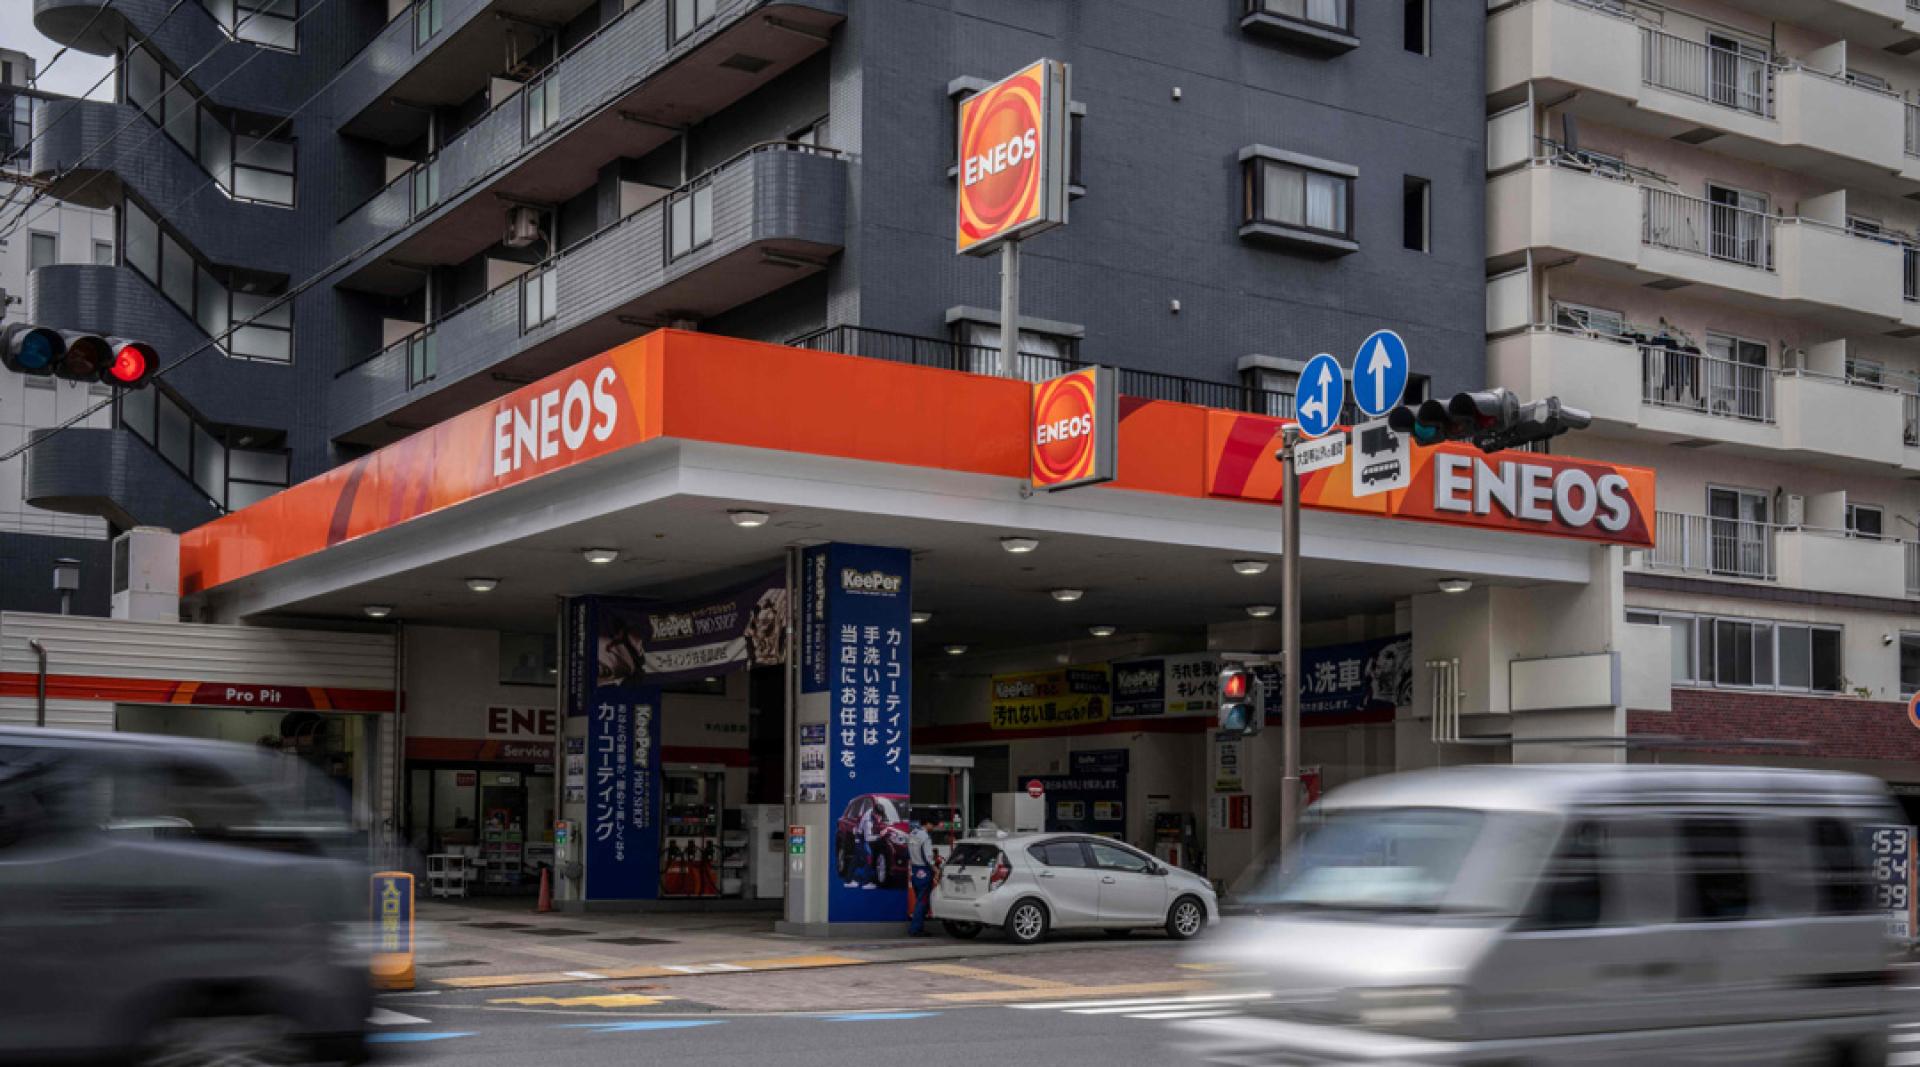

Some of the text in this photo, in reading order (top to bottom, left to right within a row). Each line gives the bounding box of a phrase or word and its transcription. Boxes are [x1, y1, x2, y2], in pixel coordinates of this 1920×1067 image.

[964, 127, 1036, 187] ENEOS
[494, 367, 618, 476] ENEOS
[1036, 413, 1091, 445] ENEOS
[1434, 453, 1631, 531] ENEOS
[841, 569, 902, 592] KeePer
[225, 687, 282, 704] Pro Pit
[840, 624, 857, 779] 当店にお任せを。
[863, 625, 880, 746] 手洗い洗車は
[885, 628, 902, 773] カーコーティング、
[1263, 658, 1361, 697] 手い洗車
[504, 744, 550, 758] Service
[634, 705, 651, 768] KeePer
[594, 701, 616, 841] カーコーティング
